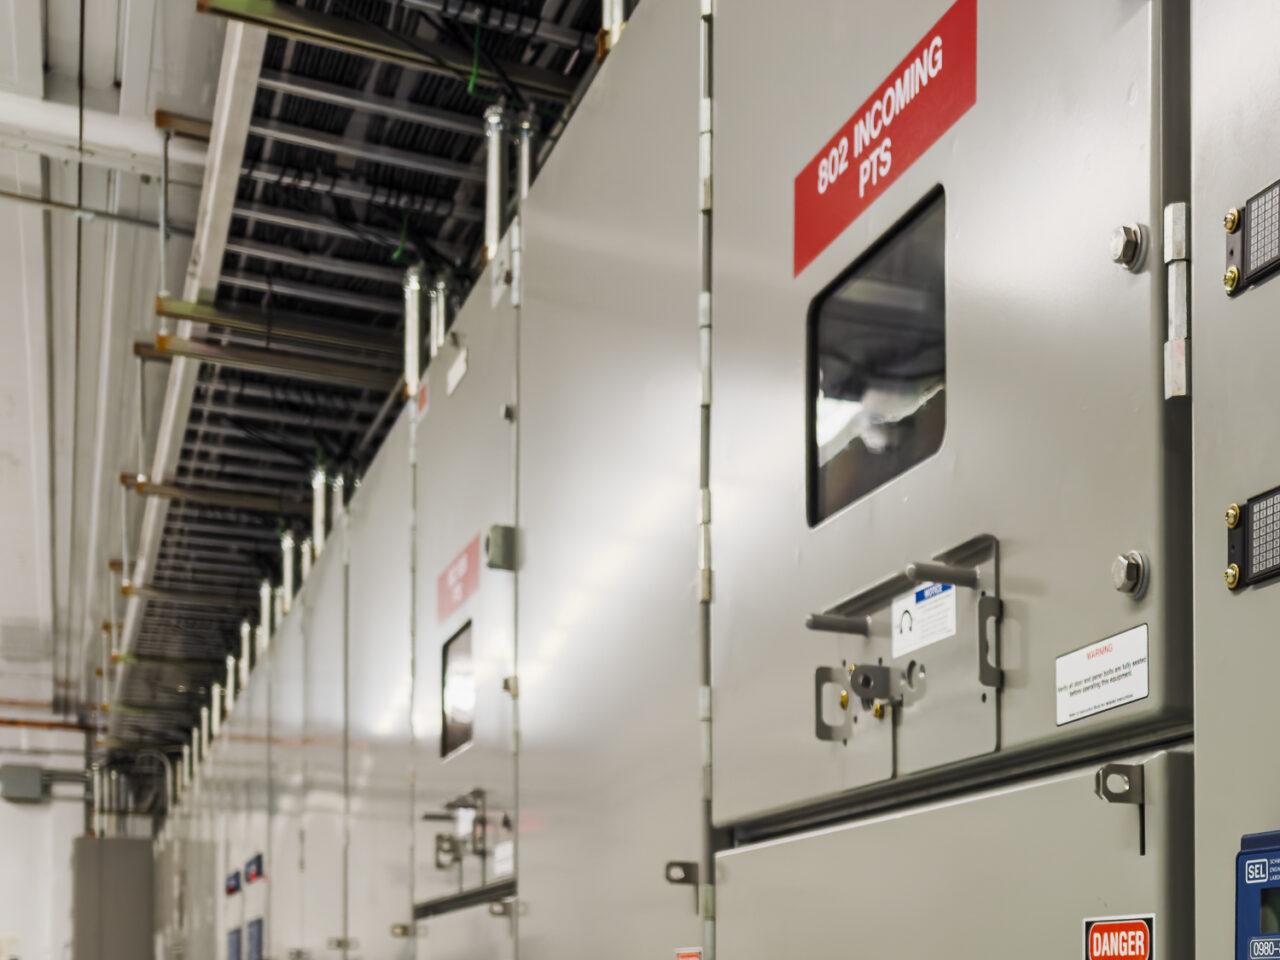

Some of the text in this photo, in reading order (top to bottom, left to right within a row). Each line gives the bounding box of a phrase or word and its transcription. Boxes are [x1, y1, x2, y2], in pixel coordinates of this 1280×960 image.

[817, 36, 942, 194] 802 INCOMING
[859, 137, 892, 198] PTS
[1248, 864, 1266, 879] SEL
[1093, 931, 1144, 957] DANGER
